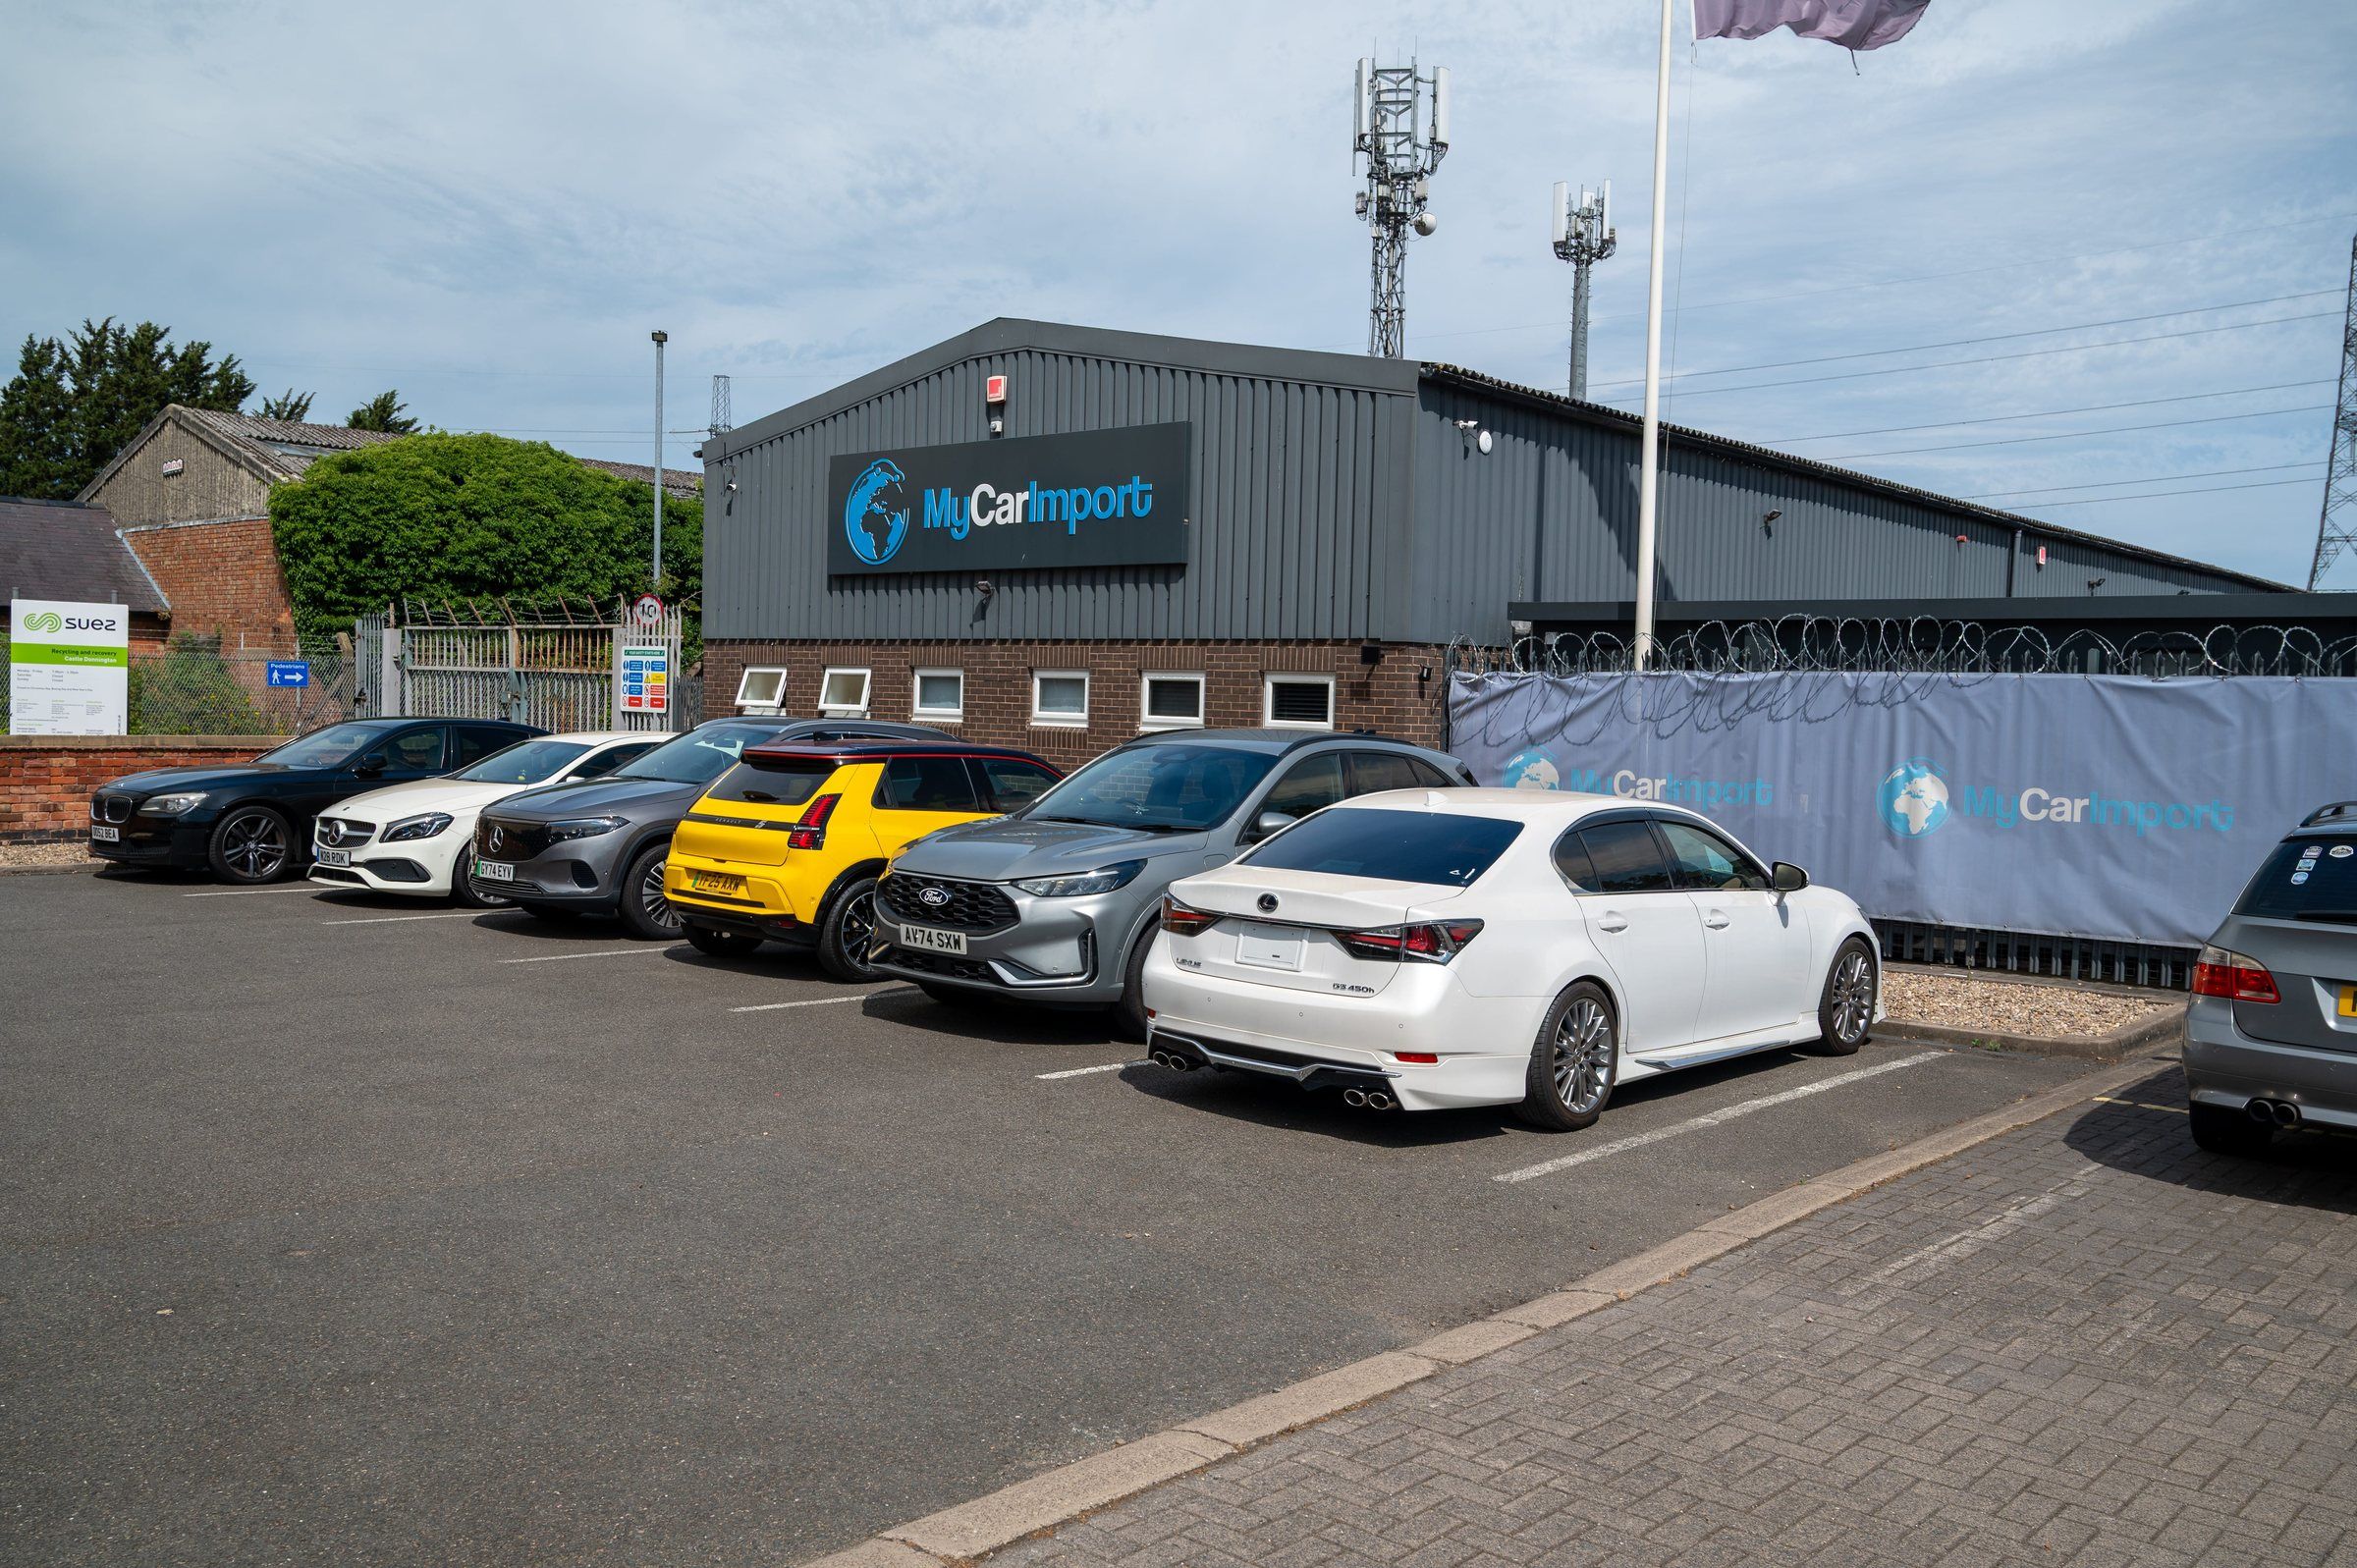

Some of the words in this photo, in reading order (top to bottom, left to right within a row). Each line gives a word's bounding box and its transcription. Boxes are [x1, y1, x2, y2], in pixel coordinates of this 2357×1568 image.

[923, 475, 1153, 540] MyCarImport
[639, 603, 657, 619] 10
[65, 618, 116, 631] suez
[1963, 785, 2235, 838] MyCarImport
[331, 851, 346, 864] RDK
[481, 862, 497, 877] GY74
[923, 890, 944, 903] Ford
[904, 927, 934, 946] AV74
[936, 932, 961, 951] SXW
[1347, 985, 1375, 994] 450h
